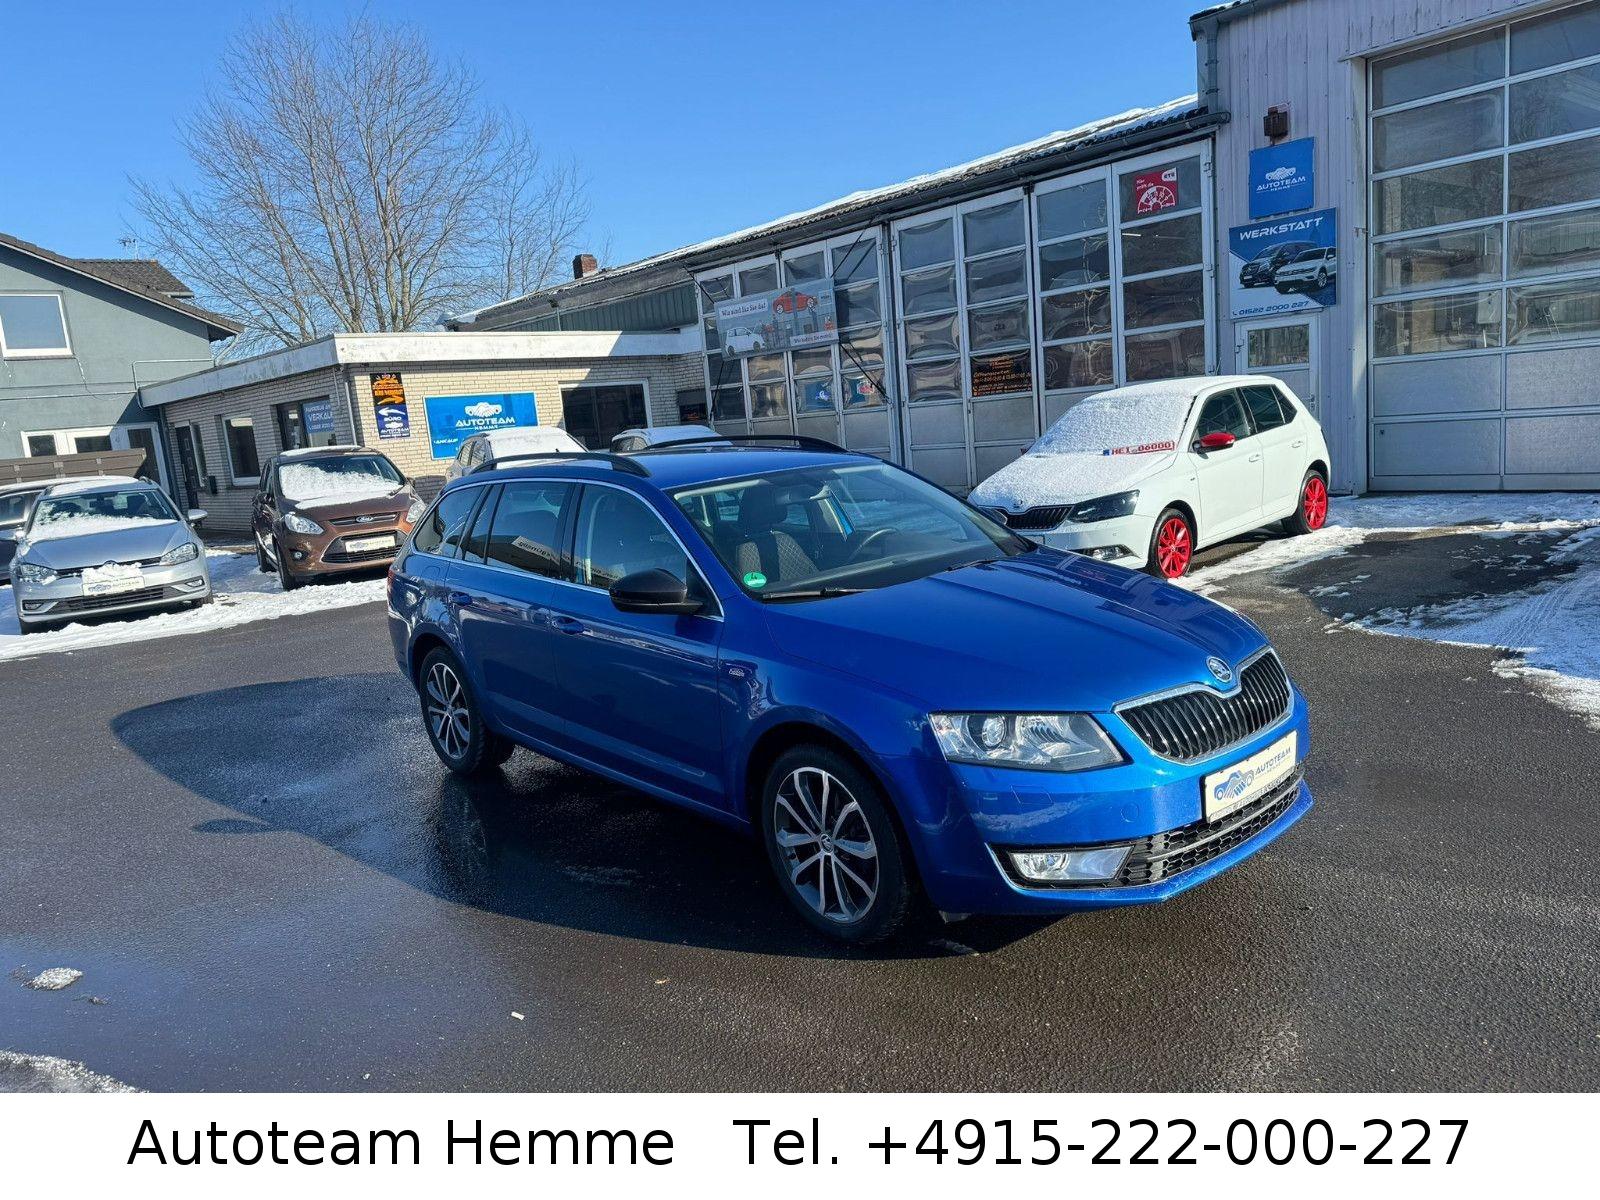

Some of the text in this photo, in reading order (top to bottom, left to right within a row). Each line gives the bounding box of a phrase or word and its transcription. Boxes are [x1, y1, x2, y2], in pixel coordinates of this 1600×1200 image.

[1256, 176, 1306, 192] AUTOTEAM
[1239, 216, 1323, 241] WERKSTATT
[1239, 300, 1309, 316] 01522 2000 227
[455, 416, 515, 428] AUTOTEAM
[1255, 746, 1291, 775] AUTOTEAM
